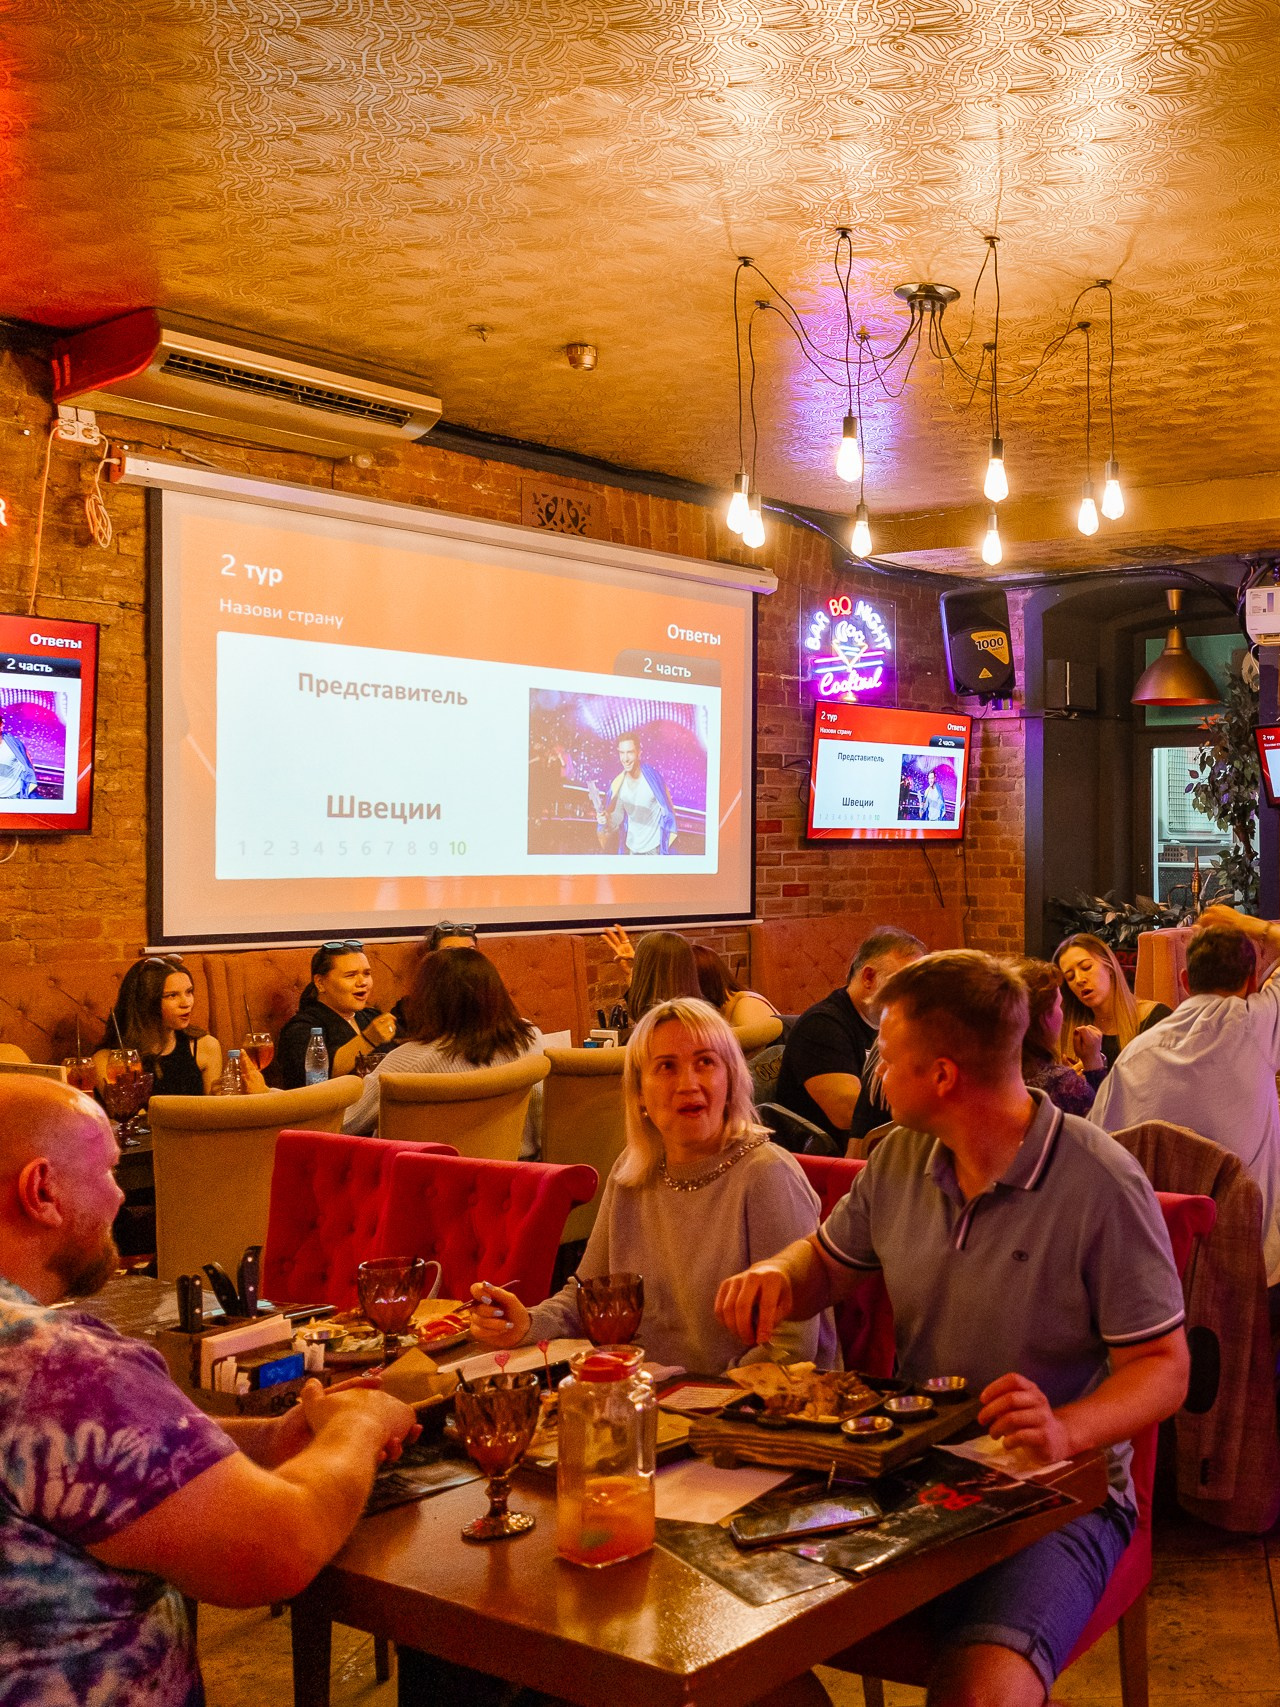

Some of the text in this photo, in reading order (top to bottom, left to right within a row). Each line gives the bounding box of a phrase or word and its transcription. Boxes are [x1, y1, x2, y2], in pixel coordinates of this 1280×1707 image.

[220, 554, 284, 586] 2 тур
[219, 598, 344, 629] Назови страну
[805, 596, 892, 650] BAR BQ NIGHT
[29, 633, 82, 649] Ответы
[667, 624, 721, 645] Ответы
[975, 637, 1004, 650] 1000
[6, 658, 53, 673] 2 часть
[643, 657, 692, 678] 2 часть
[298, 672, 469, 707] Представитель
[821, 711, 826, 720] 2
[837, 752, 885, 763] Представитель
[326, 794, 442, 824] Швеции
[842, 797, 874, 808] Швеции
[238, 840, 467, 856] 1 2 3 4 5 6 7 8 9 10
